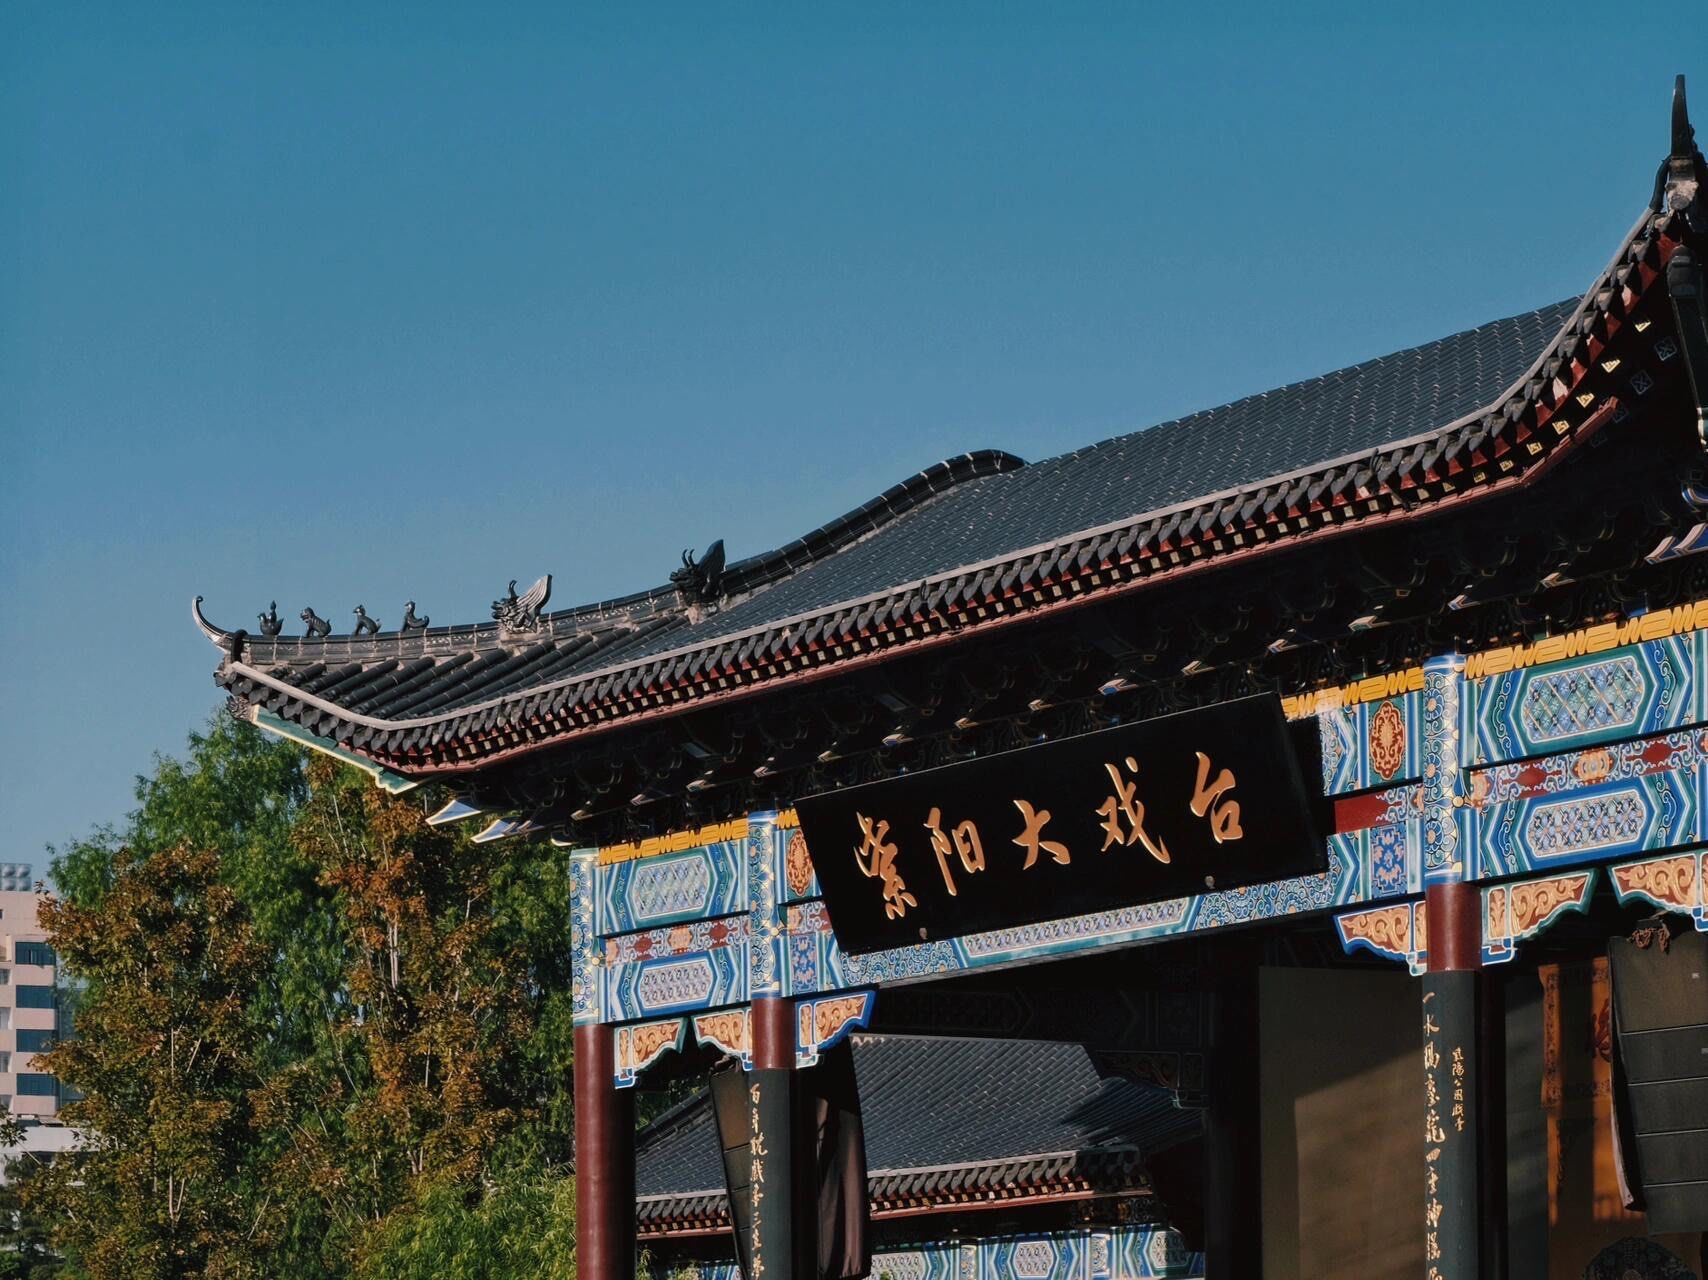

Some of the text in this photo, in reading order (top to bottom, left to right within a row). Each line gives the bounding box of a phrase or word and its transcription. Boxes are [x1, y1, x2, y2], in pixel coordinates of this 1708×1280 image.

[853, 750, 1244, 921] 紫阳大戏台
